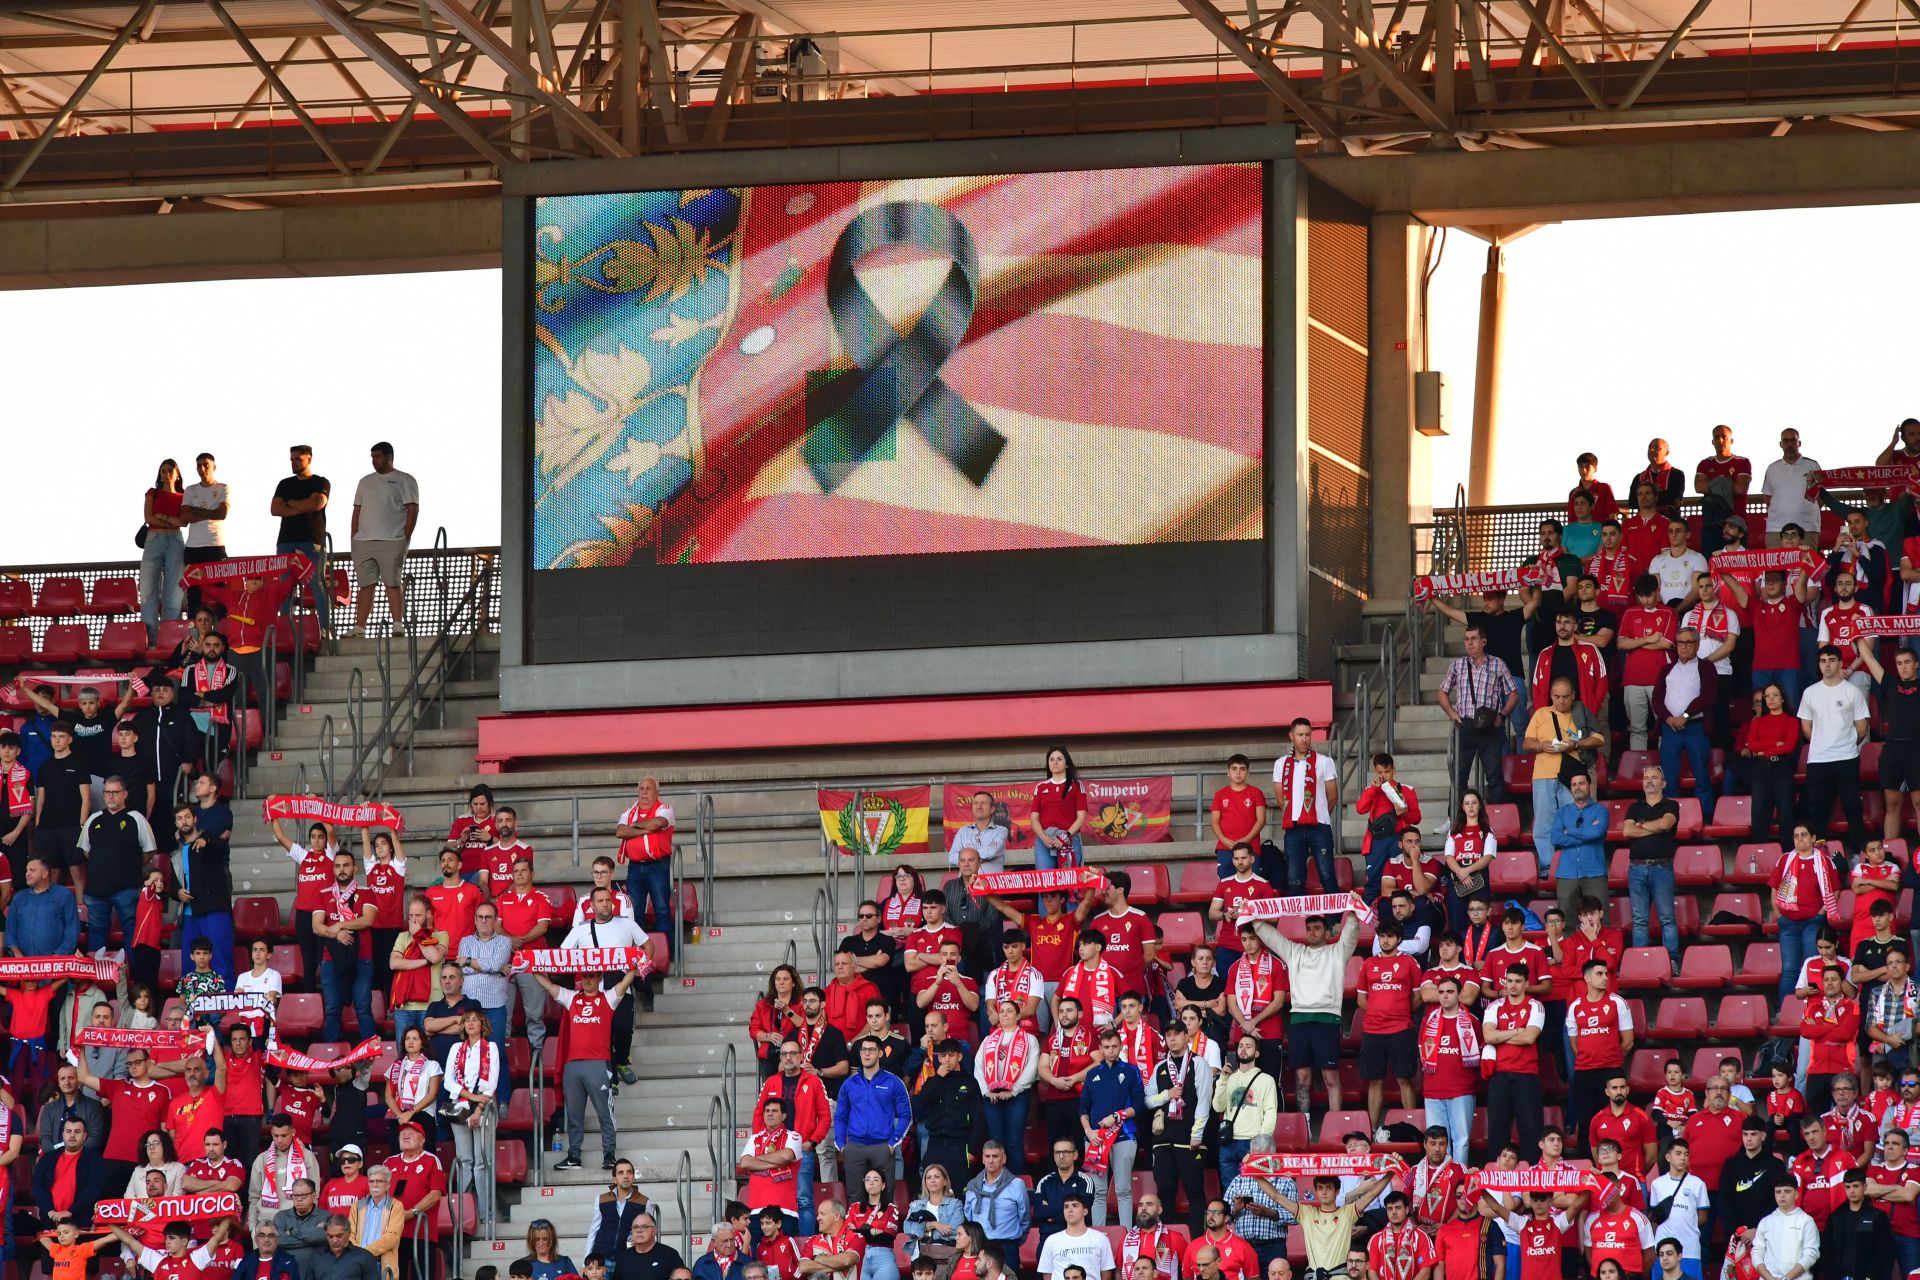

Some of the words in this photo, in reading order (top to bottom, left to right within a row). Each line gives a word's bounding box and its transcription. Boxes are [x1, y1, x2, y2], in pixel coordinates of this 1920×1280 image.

[1826, 470, 1853, 480] REAL
[1747, 553, 1756, 567] ES
[1757, 553, 1766, 566] LA
[1766, 552, 1779, 567] QUE
[205, 565, 214, 579] TU
[238, 561, 247, 575] ES
[247, 560, 255, 575] LA
[255, 559, 268, 573] QUE
[268, 556, 288, 571] CANTA
[1430, 568, 1518, 590] MURCIA
[1431, 588, 1454, 596] COMO
[1456, 587, 1474, 595] UNA
[1478, 584, 1497, 592] SOLA
[1499, 581, 1521, 590] ALMA
[1856, 618, 1889, 630] REAL
[1088, 782, 1149, 799] Imperio
[291, 799, 299, 814] TU
[323, 801, 332, 817] ES
[332, 804, 340, 819] LA
[341, 806, 355, 822] QUE
[355, 807, 377, 821] CANTA
[987, 875, 996, 889] TU
[1024, 873, 1033, 887] ES
[1033, 874, 1042, 887] LA
[1042, 872, 1056, 888] QUE
[1056, 871, 1077, 886] CANTA
[1036, 934, 1062, 945] SPQR
[532, 948, 628, 966] MURCIA
[0, 961, 30, 974] MURCIA
[31, 961, 51, 973] CLUB
[54, 961, 63, 971] DE
[532, 964, 556, 973] COMO
[559, 965, 578, 973] UNA
[581, 964, 603, 972] SOLA
[606, 963, 630, 972] ALMA
[84, 1031, 108, 1041] REAL
[111, 1031, 153, 1044] MURCIA
[157, 1035, 177, 1045] C.F.
[287, 1052, 311, 1069] COMO
[1282, 1157, 1317, 1168] REAL
[1320, 1156, 1371, 1168] MURCIA
[1480, 1171, 1489, 1185] TU
[1520, 1171, 1529, 1186] ES
[1530, 1171, 1540, 1186] LA
[1541, 1171, 1556, 1189] QUE
[1557, 1171, 1580, 1186] CANTA
[158, 1195, 236, 1218] murcia
[55, 1260, 70, 1268] win
